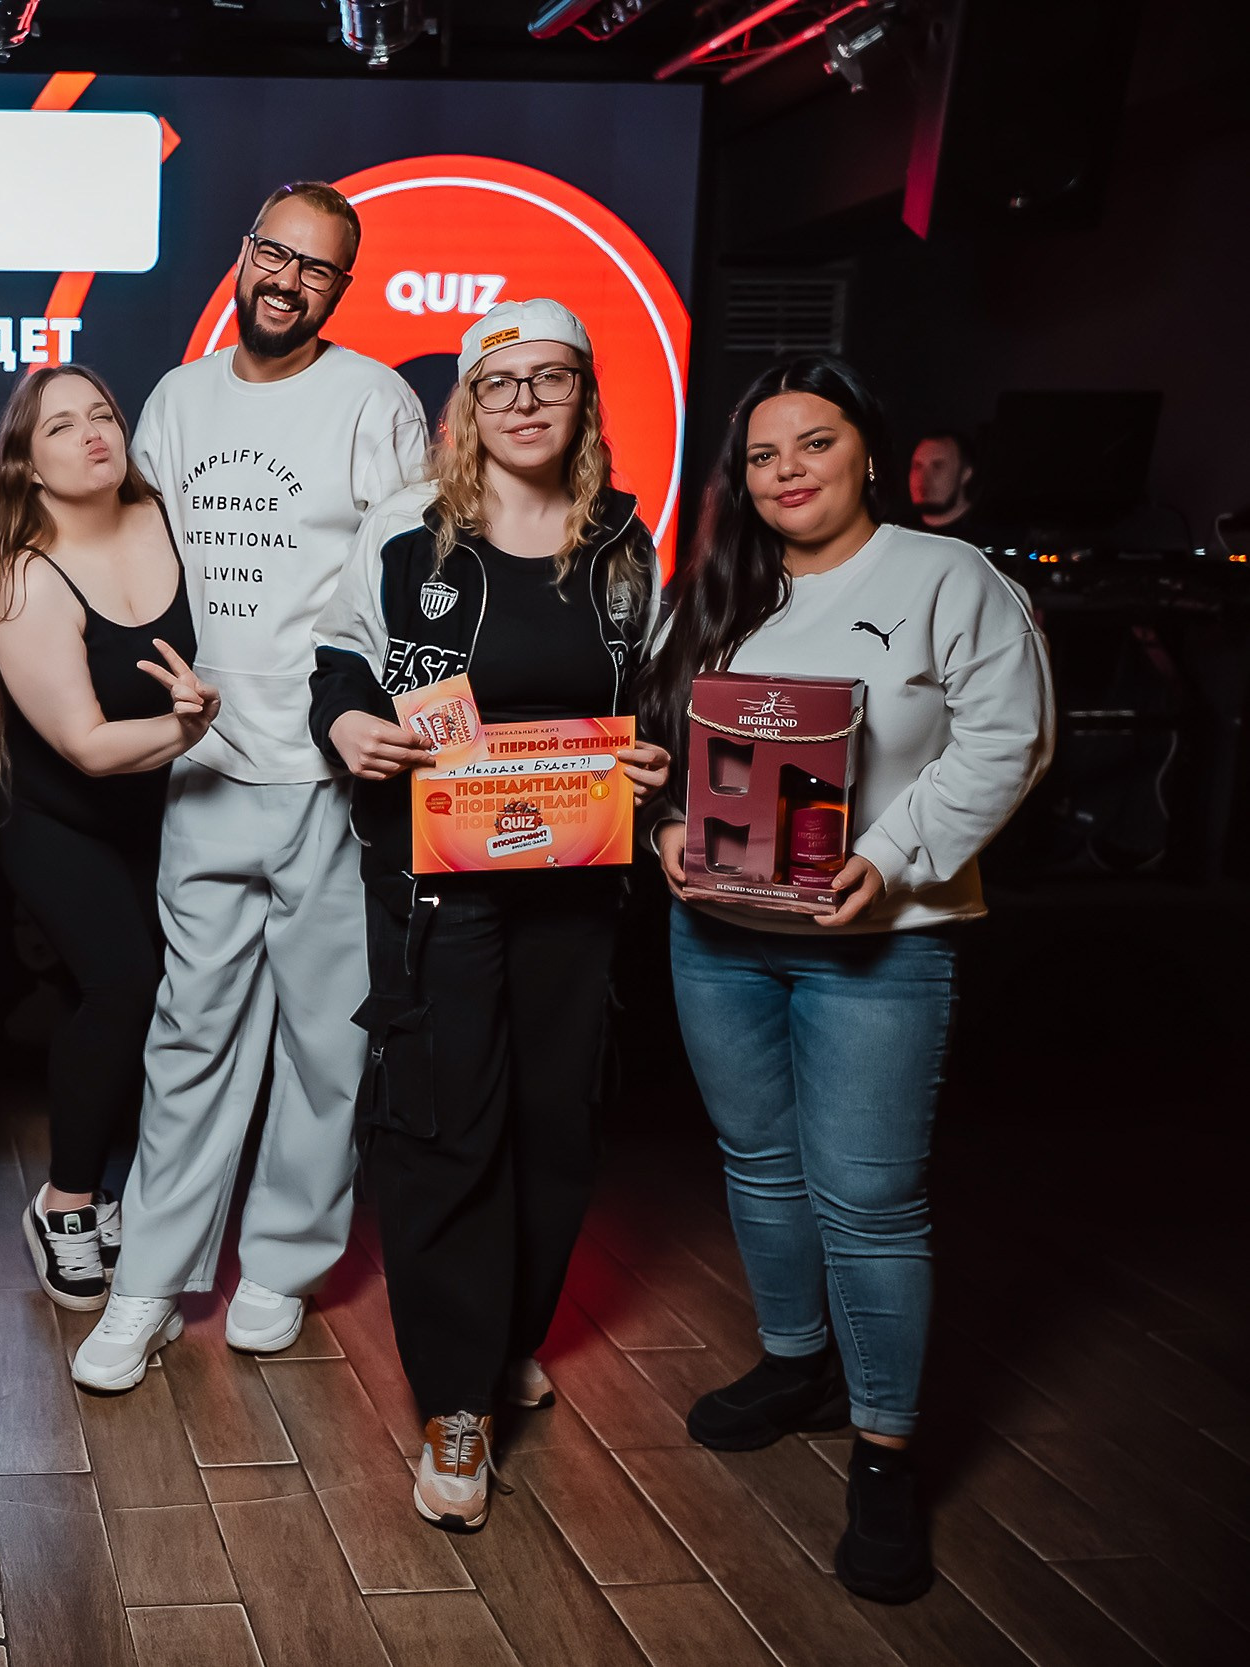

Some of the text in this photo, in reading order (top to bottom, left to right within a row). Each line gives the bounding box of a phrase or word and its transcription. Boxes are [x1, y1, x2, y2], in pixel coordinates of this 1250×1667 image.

[386, 271, 506, 315] QUIZ
[182, 450, 303, 497] SIMPLIFY LIFE
[192, 496, 279, 511] EMBRACE
[204, 566, 263, 583] LIVING
[208, 602, 258, 618] DAILY
[432, 716, 447, 743] QUIZ
[738, 715, 798, 728] HIGHLAND
[499, 737, 558, 753] ПЕРВОЙ
[562, 735, 630, 750] СТЕПЕНИ
[455, 775, 589, 796] ПОБЕДИТЕЛИ!
[455, 793, 588, 814] ПОБЕТЕЛИ!
[501, 815, 536, 830] QUIZ
[716, 884, 799, 899] BLENDED SCOTCH WHISKY
